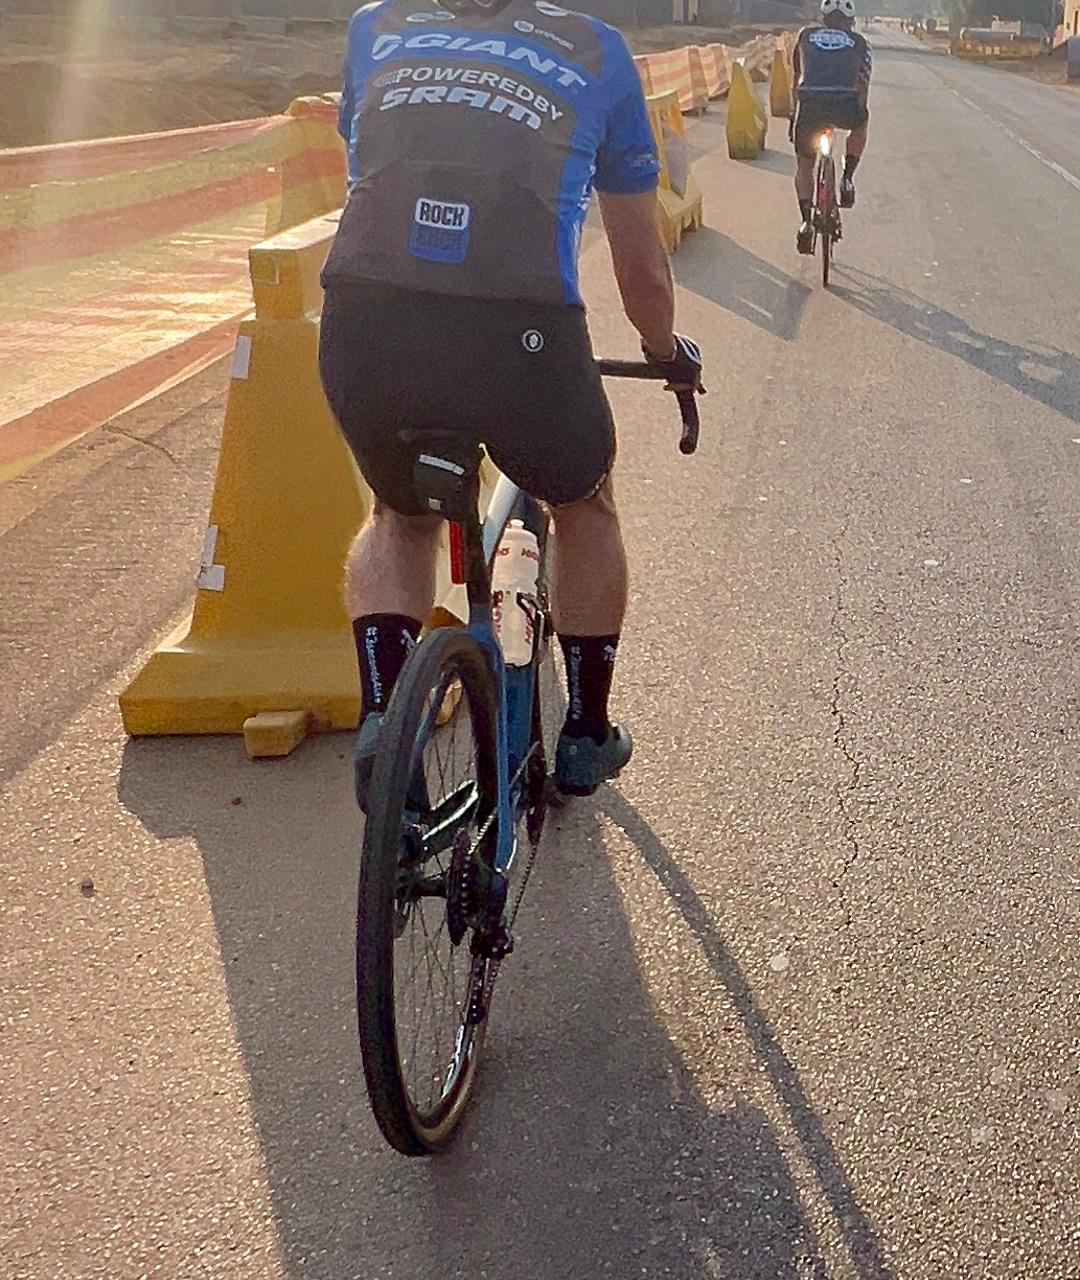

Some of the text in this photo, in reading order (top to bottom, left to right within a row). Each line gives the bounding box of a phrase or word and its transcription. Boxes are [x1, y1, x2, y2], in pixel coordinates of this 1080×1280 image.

[404, 33, 588, 87] GIANT
[379, 85, 542, 130] SRAM
[419, 200, 465, 227] ROCK
